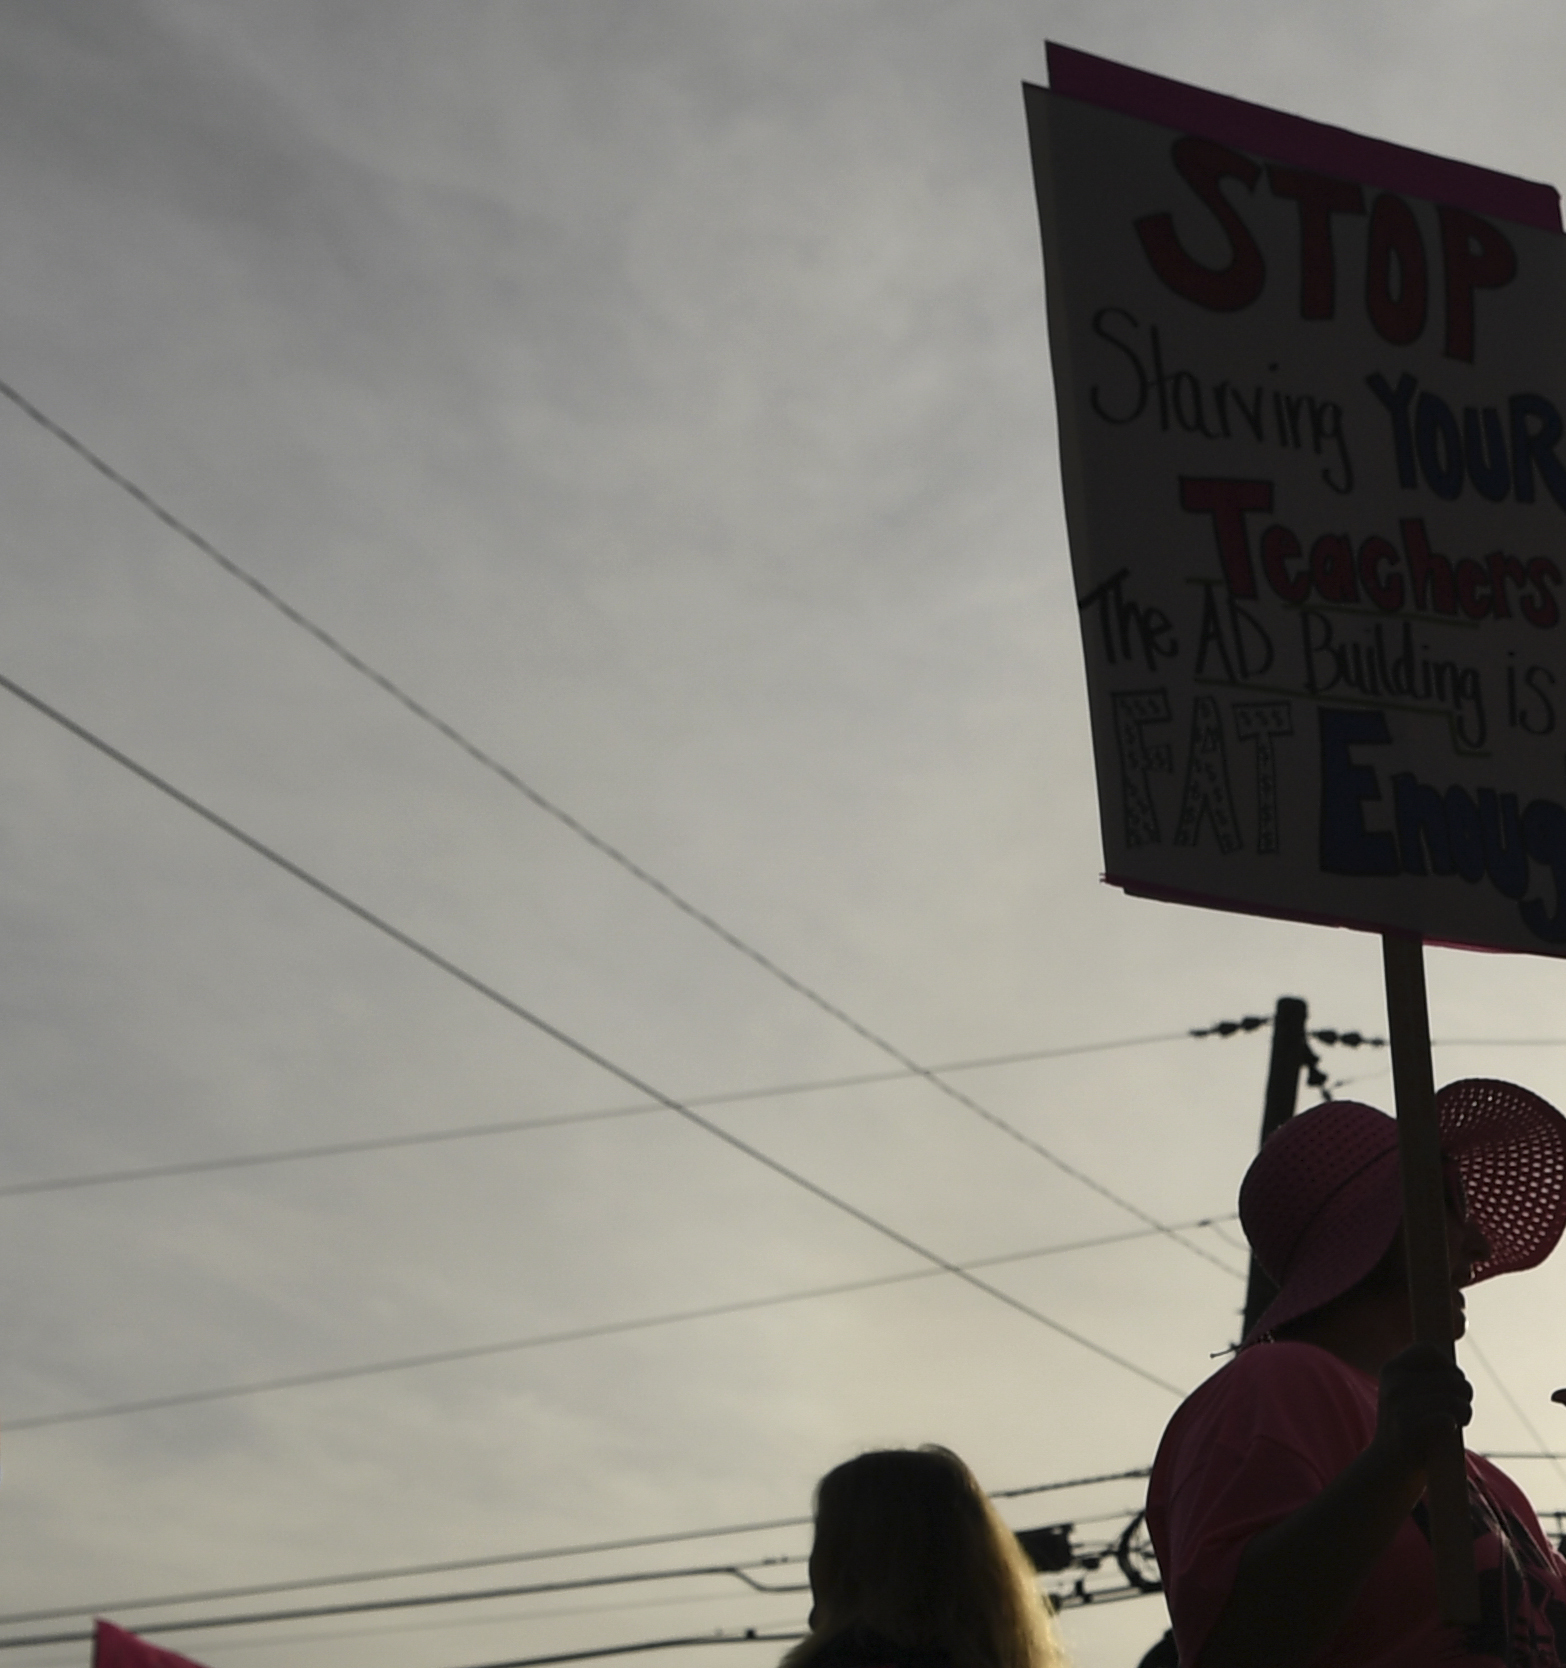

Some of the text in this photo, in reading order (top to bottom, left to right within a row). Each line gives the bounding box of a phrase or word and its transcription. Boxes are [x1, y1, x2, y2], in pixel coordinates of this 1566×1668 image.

[1134, 135, 1518, 362] STOP
[1092, 308, 1354, 493] Starving
[1179, 477, 1562, 629] Teachers
[1080, 568, 1178, 671] The
[1302, 613, 1486, 749] Building
[1111, 688, 1293, 856] FAT
